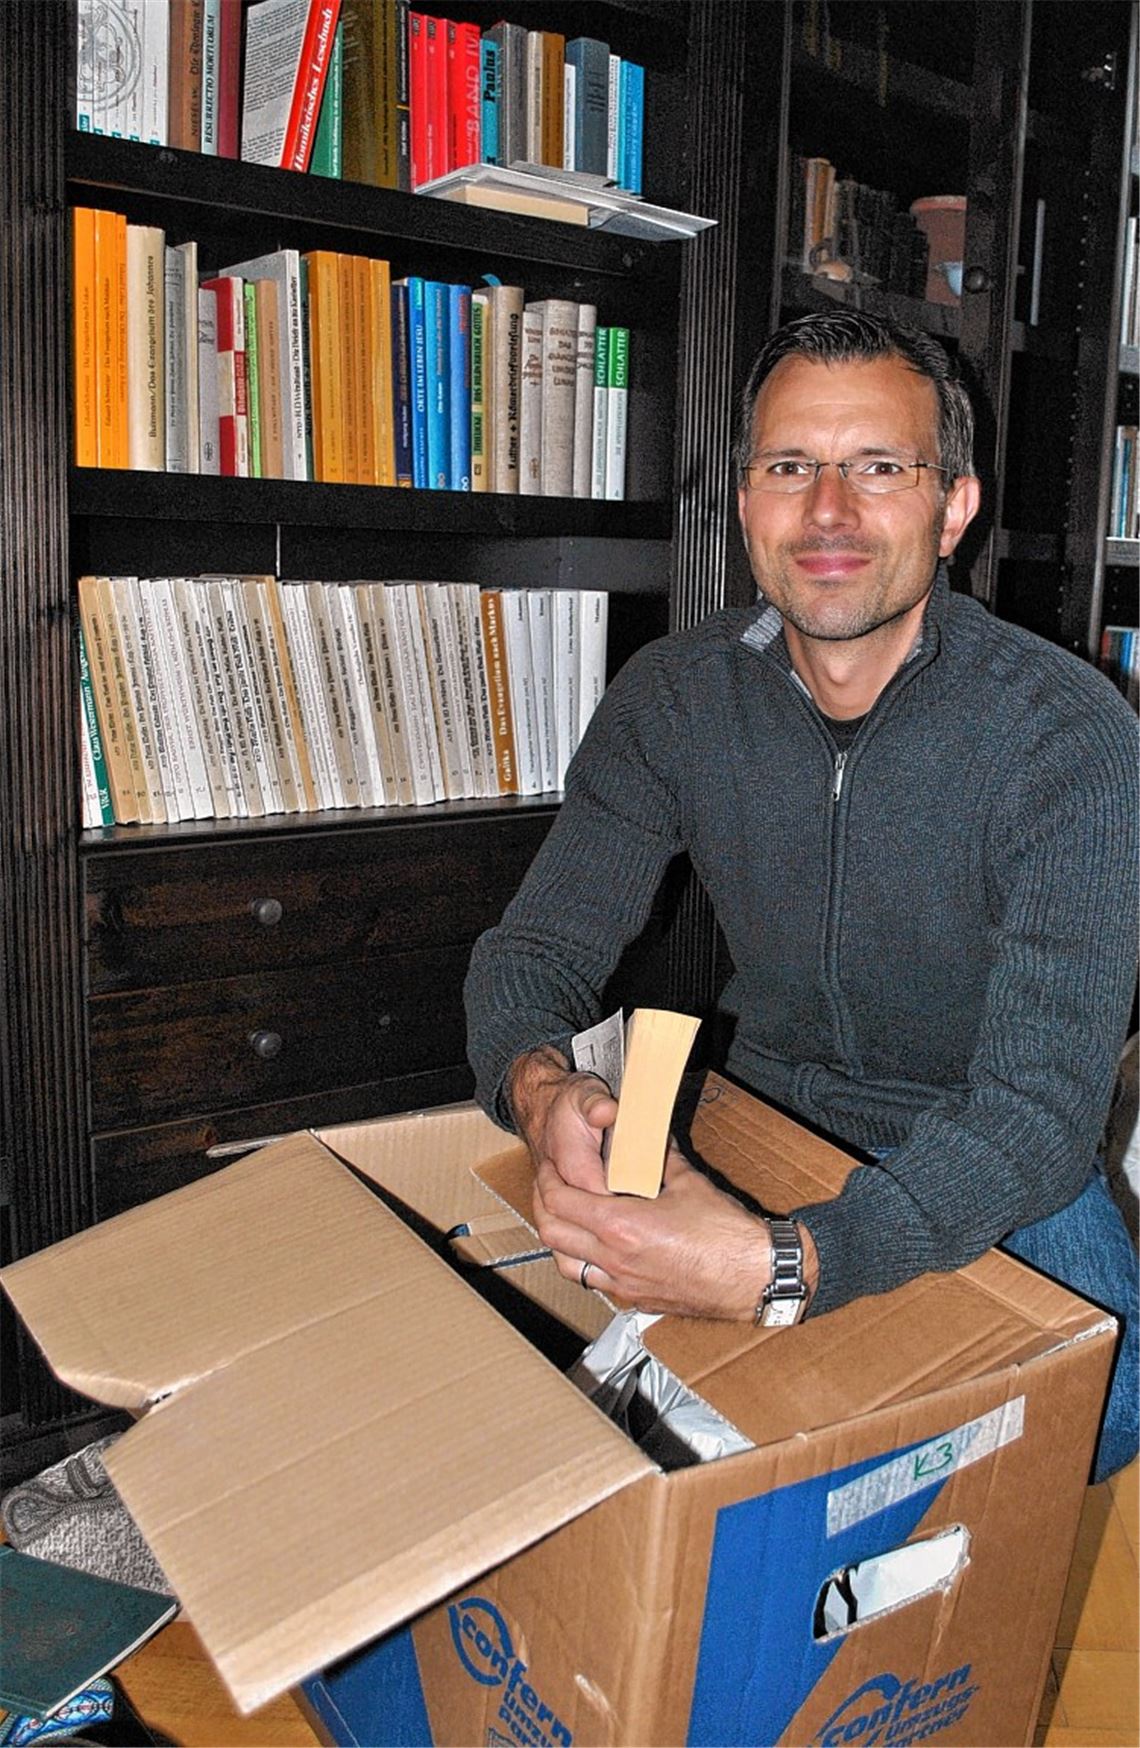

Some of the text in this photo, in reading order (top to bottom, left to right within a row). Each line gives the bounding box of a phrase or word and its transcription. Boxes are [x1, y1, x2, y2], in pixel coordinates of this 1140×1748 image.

[292, 8, 335, 172] Homiletisches Lesebuch
[466, 65, 480, 131] BAND
[483, 49, 497, 103] Paulus
[415, 346, 424, 373] LEBEN
[597, 328, 607, 384] SCHLATTER
[616, 329, 626, 385] SCHLATTER
[485, 598, 499, 635] Markus
[489, 637, 501, 658] nach
[82, 687, 100, 738] Westermann
[491, 661, 507, 715] Evangelium
[497, 718, 509, 735] Das
[914, 1443, 952, 1480] K3
